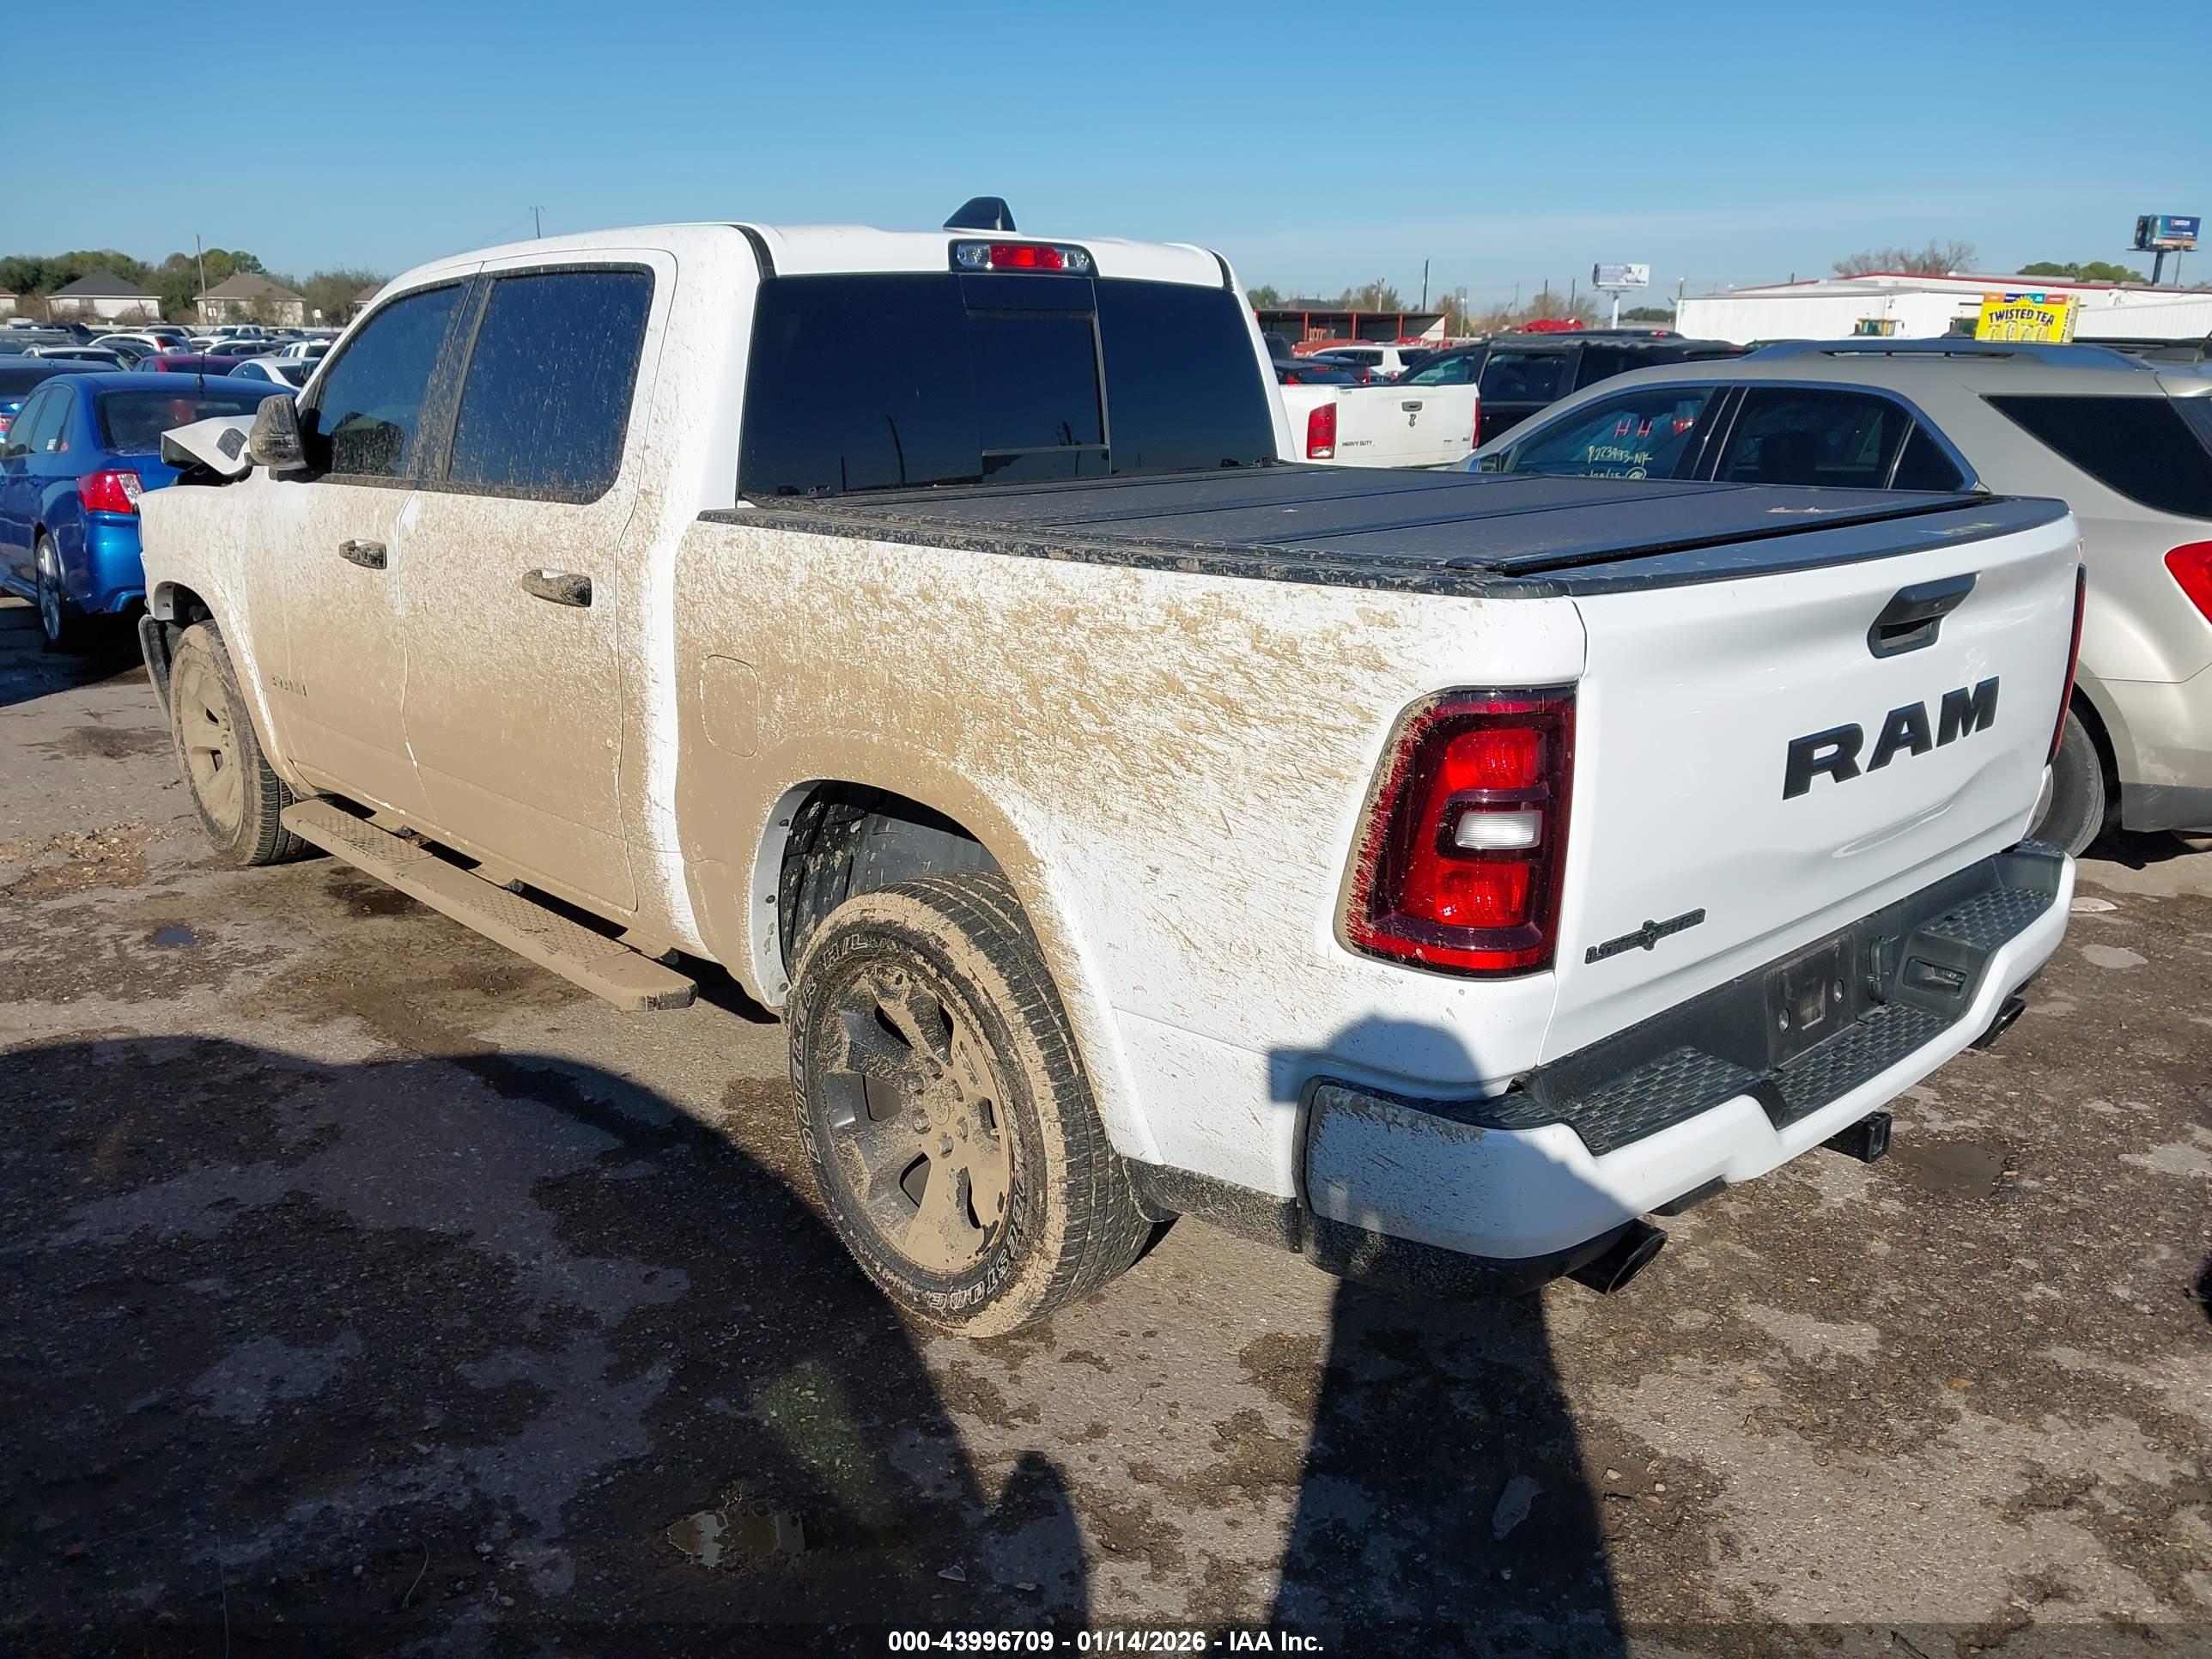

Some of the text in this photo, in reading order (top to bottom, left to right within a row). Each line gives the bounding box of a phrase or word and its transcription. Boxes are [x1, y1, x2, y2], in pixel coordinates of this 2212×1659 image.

[1988, 308, 2033, 324] TWISTED
[2036, 310, 2056, 326] TEA
[1782, 675, 2000, 801] RAM
[789, 975, 821, 1164] DUELER
